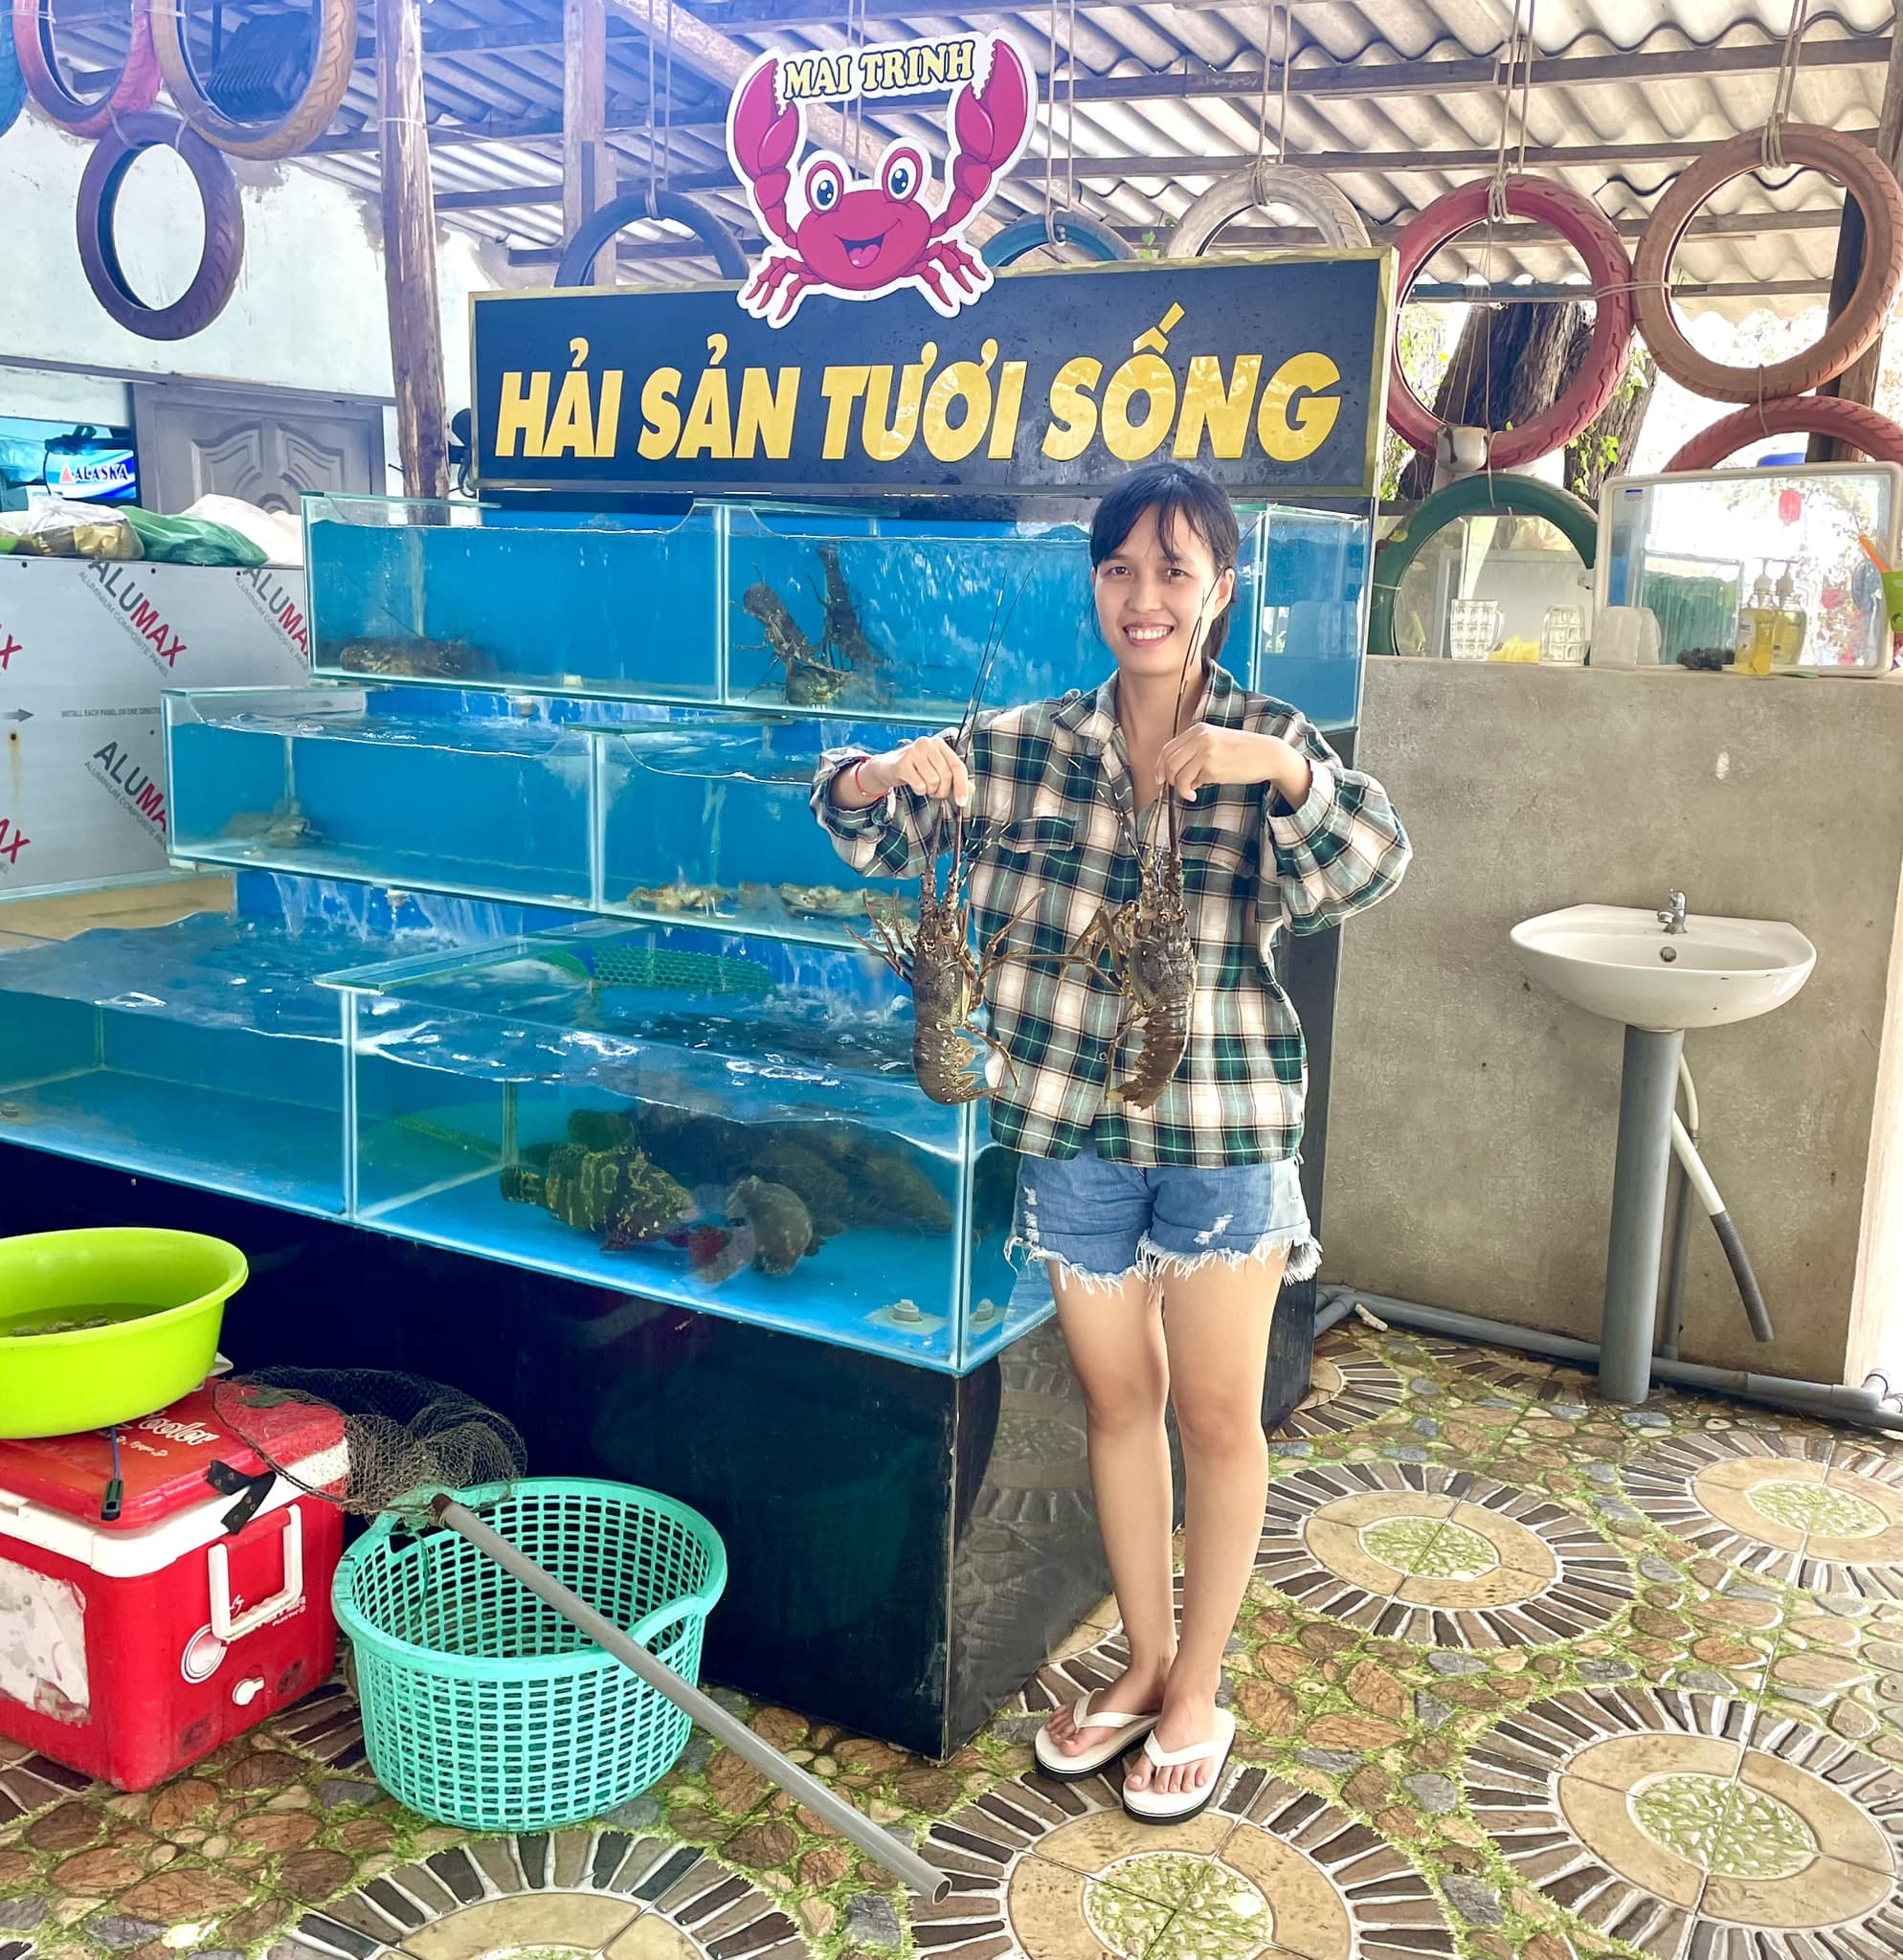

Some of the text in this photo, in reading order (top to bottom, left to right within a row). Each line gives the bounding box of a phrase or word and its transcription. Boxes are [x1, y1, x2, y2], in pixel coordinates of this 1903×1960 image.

[784, 39, 975, 100] MAI TRINH
[495, 301, 1341, 462] HẢI SẢN TƯƠI SỐNG
[76, 464, 128, 481] ALASKA
[88, 561, 188, 669] ALUMAX
[242, 567, 308, 657] ALUMA
[93, 741, 167, 833] ALUMA
